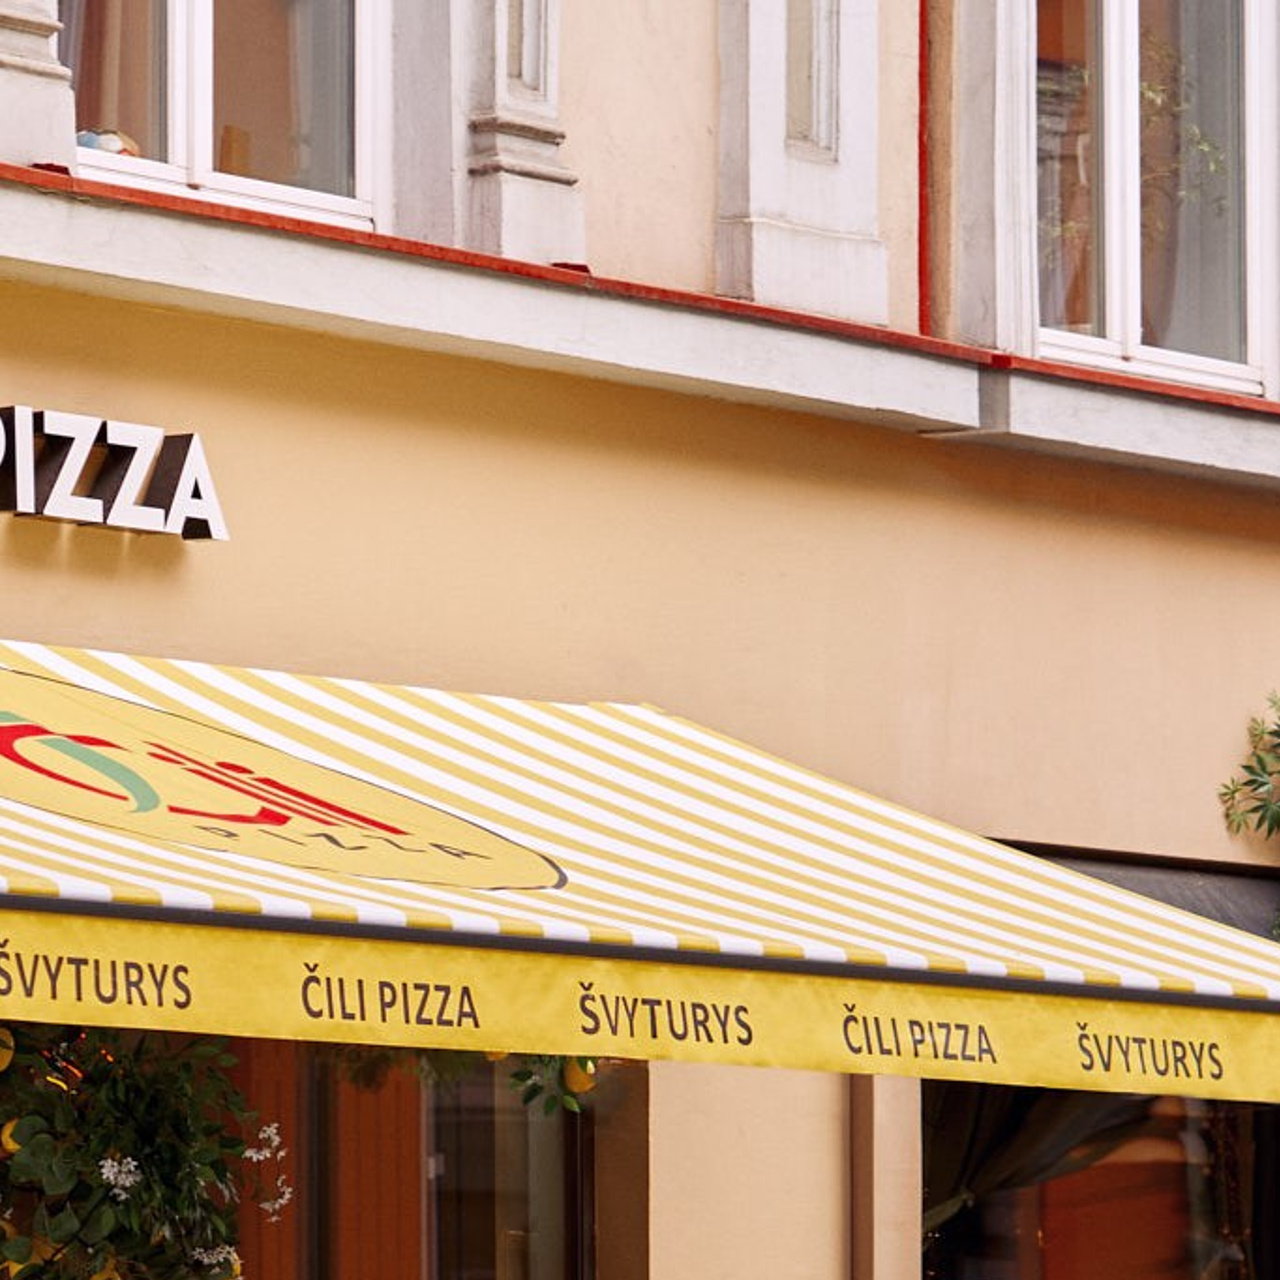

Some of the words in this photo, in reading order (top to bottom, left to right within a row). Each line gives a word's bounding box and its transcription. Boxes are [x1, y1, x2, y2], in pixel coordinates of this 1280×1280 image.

[301, 962, 366, 1022] ČILI
[378, 980, 480, 1029] PIZZA
[579, 981, 753, 1046] ŠVYTURYS
[843, 1004, 901, 1057] ČILI
[908, 1019, 997, 1064] PIZZA
[1076, 1022, 1223, 1080] ŠVYTURYS
